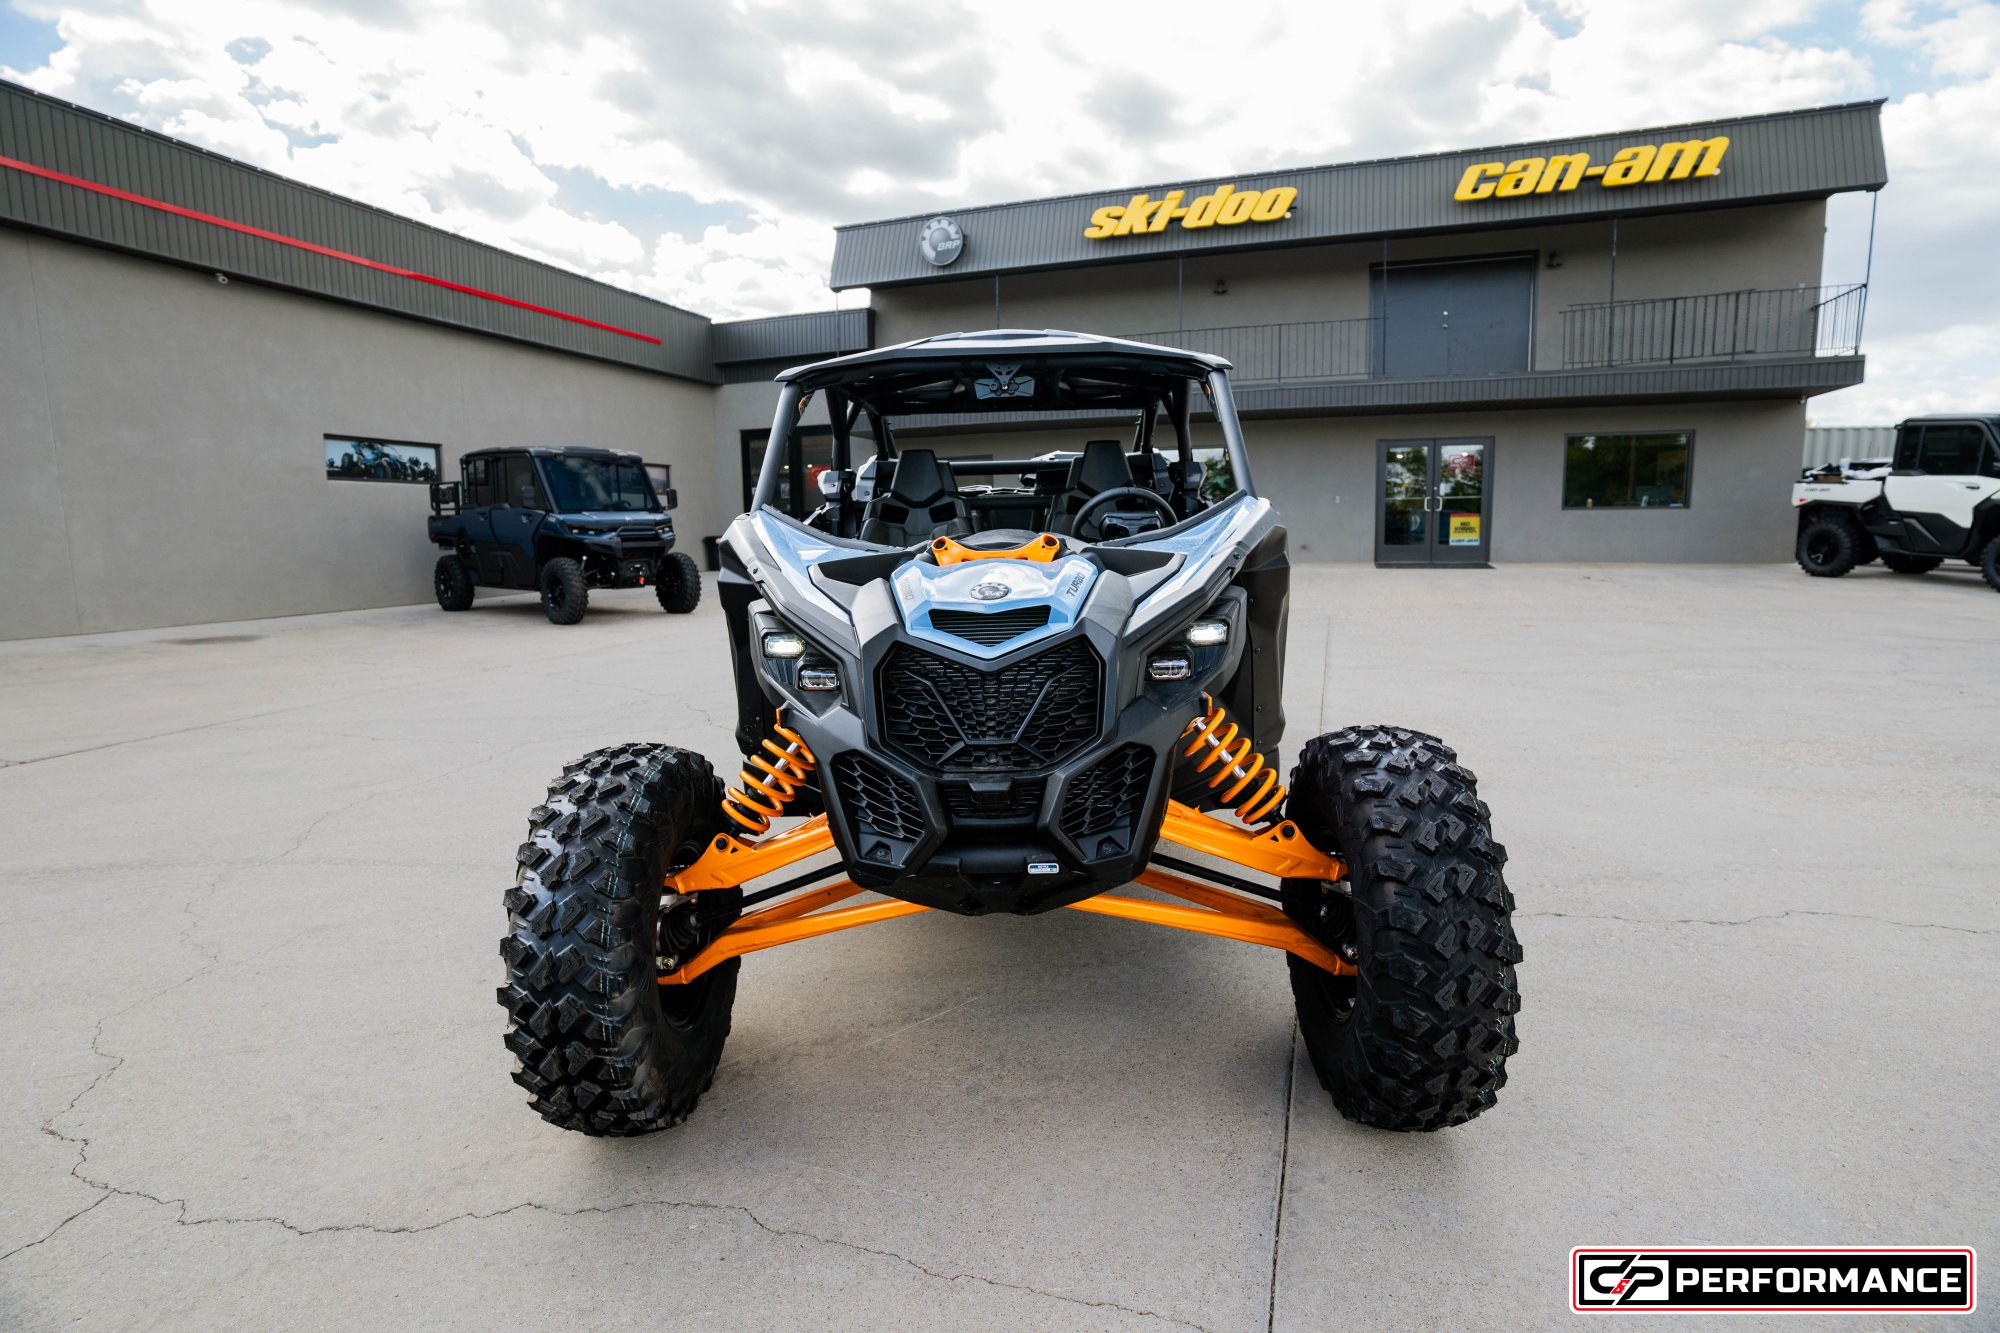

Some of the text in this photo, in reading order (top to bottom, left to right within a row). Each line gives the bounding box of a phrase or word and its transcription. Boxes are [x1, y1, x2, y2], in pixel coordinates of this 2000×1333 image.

[1453, 136, 1730, 201] can-am
[1083, 183, 1298, 239] ski-doo
[937, 239, 961, 251] BRP
[1066, 572, 1085, 597] TURBO
